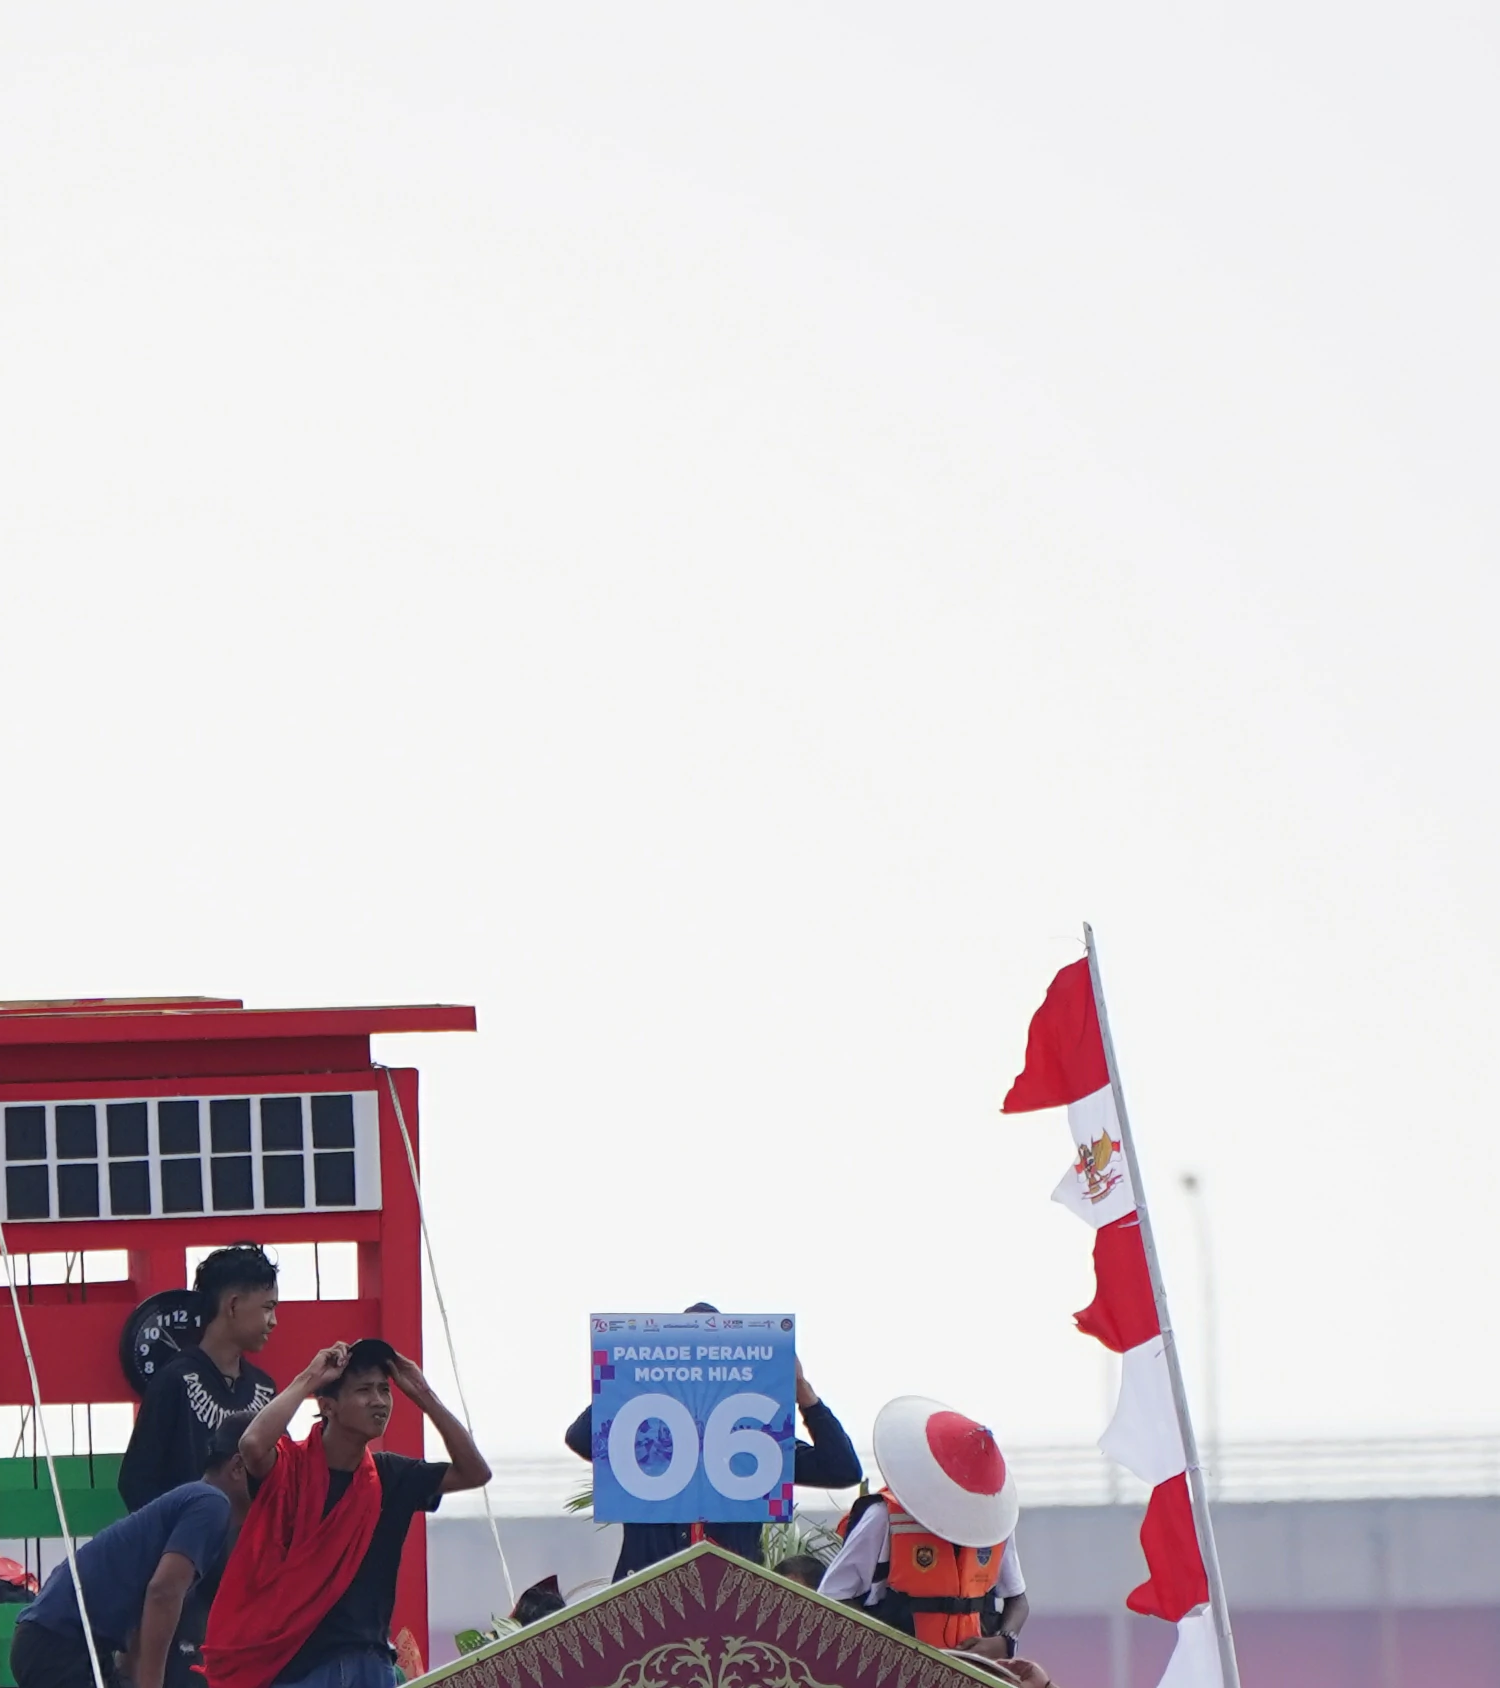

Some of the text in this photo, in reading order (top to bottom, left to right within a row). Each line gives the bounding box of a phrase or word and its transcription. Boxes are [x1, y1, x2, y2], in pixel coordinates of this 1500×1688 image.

[156, 1314, 171, 1327] 11
[172, 1310, 188, 1323] 12
[144, 1327, 160, 1340] 10
[139, 1344, 150, 1357] 9
[613, 1346, 773, 1361] PARADE PERAHU
[144, 1361, 155, 1374] 8
[634, 1367, 753, 1382] MOTOR HIAS
[607, 1392, 783, 1501] 06
